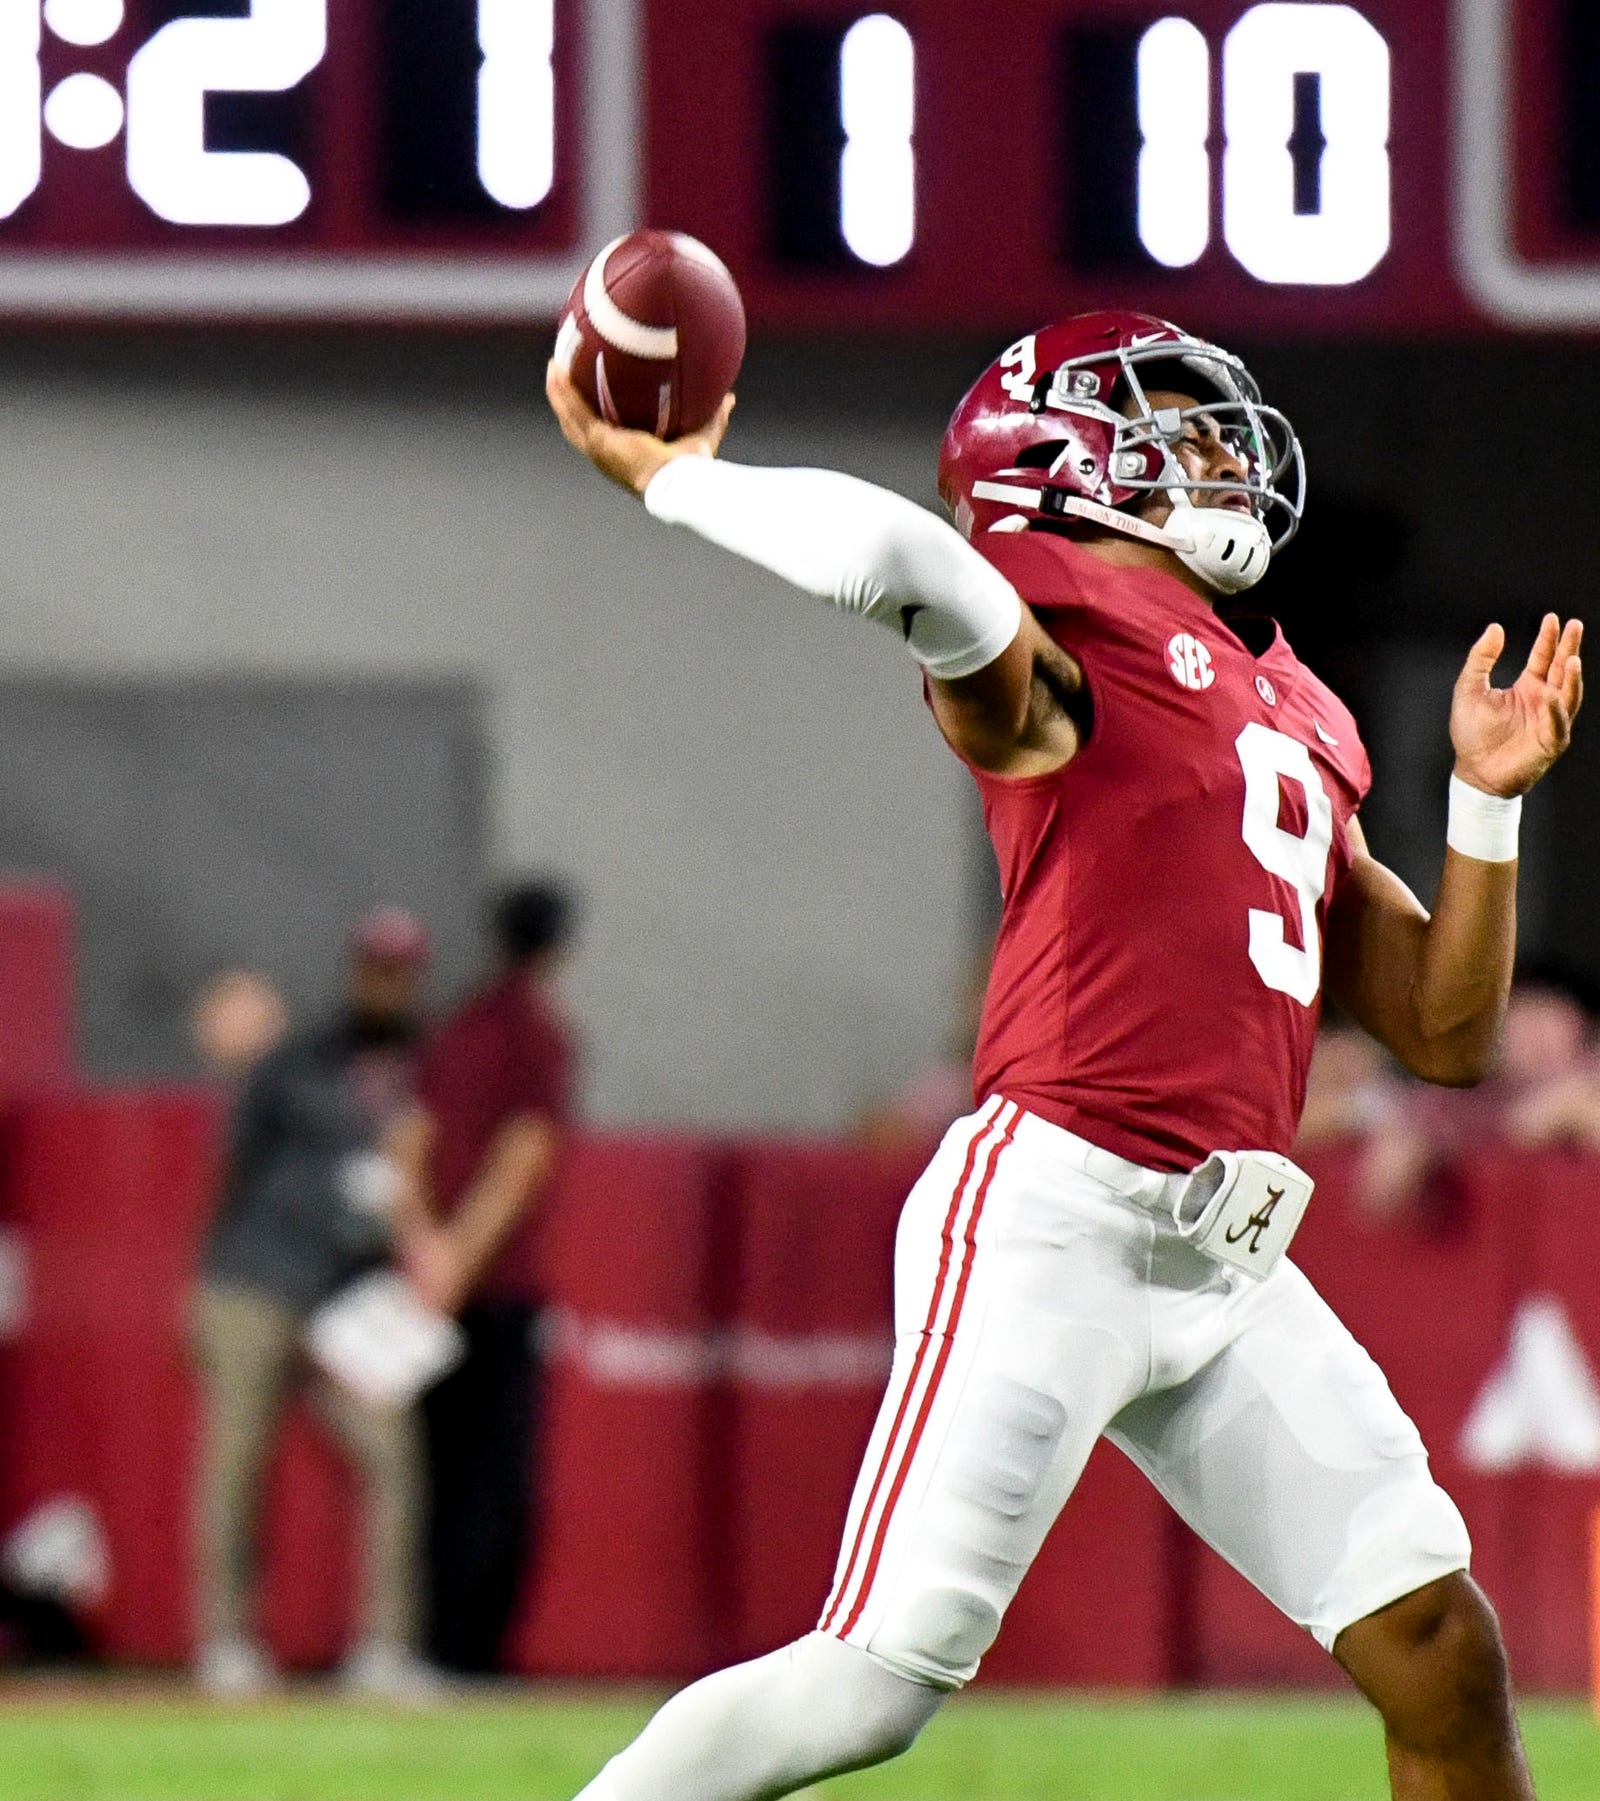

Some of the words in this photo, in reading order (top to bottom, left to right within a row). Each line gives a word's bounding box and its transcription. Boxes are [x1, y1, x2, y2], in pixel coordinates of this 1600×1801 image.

[840, 14, 915, 266] 1
[1137, 3, 1391, 286] 10
[999, 334, 1037, 403] 9
[1167, 632, 1216, 691] SEC
[1233, 721, 1333, 1008] 9
[1225, 1183, 1286, 1254] A
